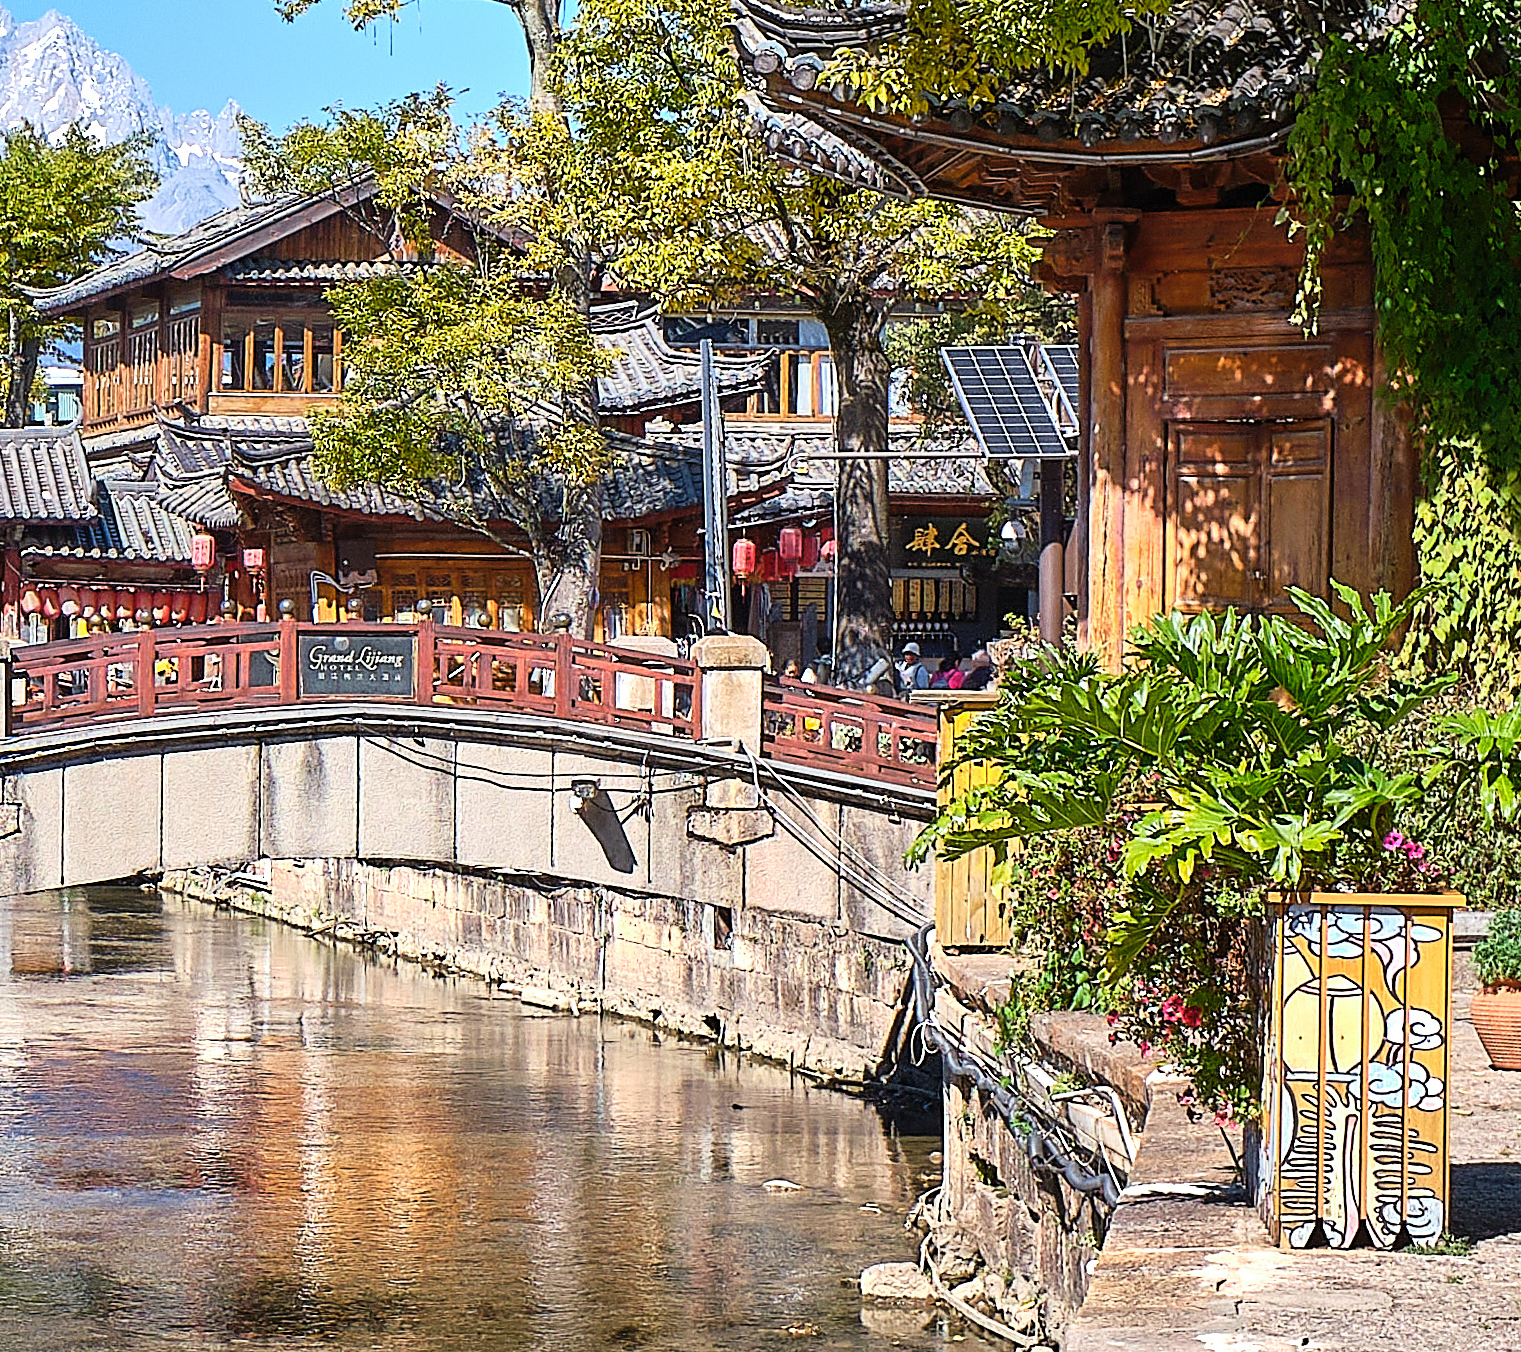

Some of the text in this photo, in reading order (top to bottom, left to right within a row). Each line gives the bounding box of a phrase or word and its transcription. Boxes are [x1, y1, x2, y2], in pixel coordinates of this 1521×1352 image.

[309, 645, 405, 671] Grand Lijiang
[320, 663, 361, 672] HOTEL
